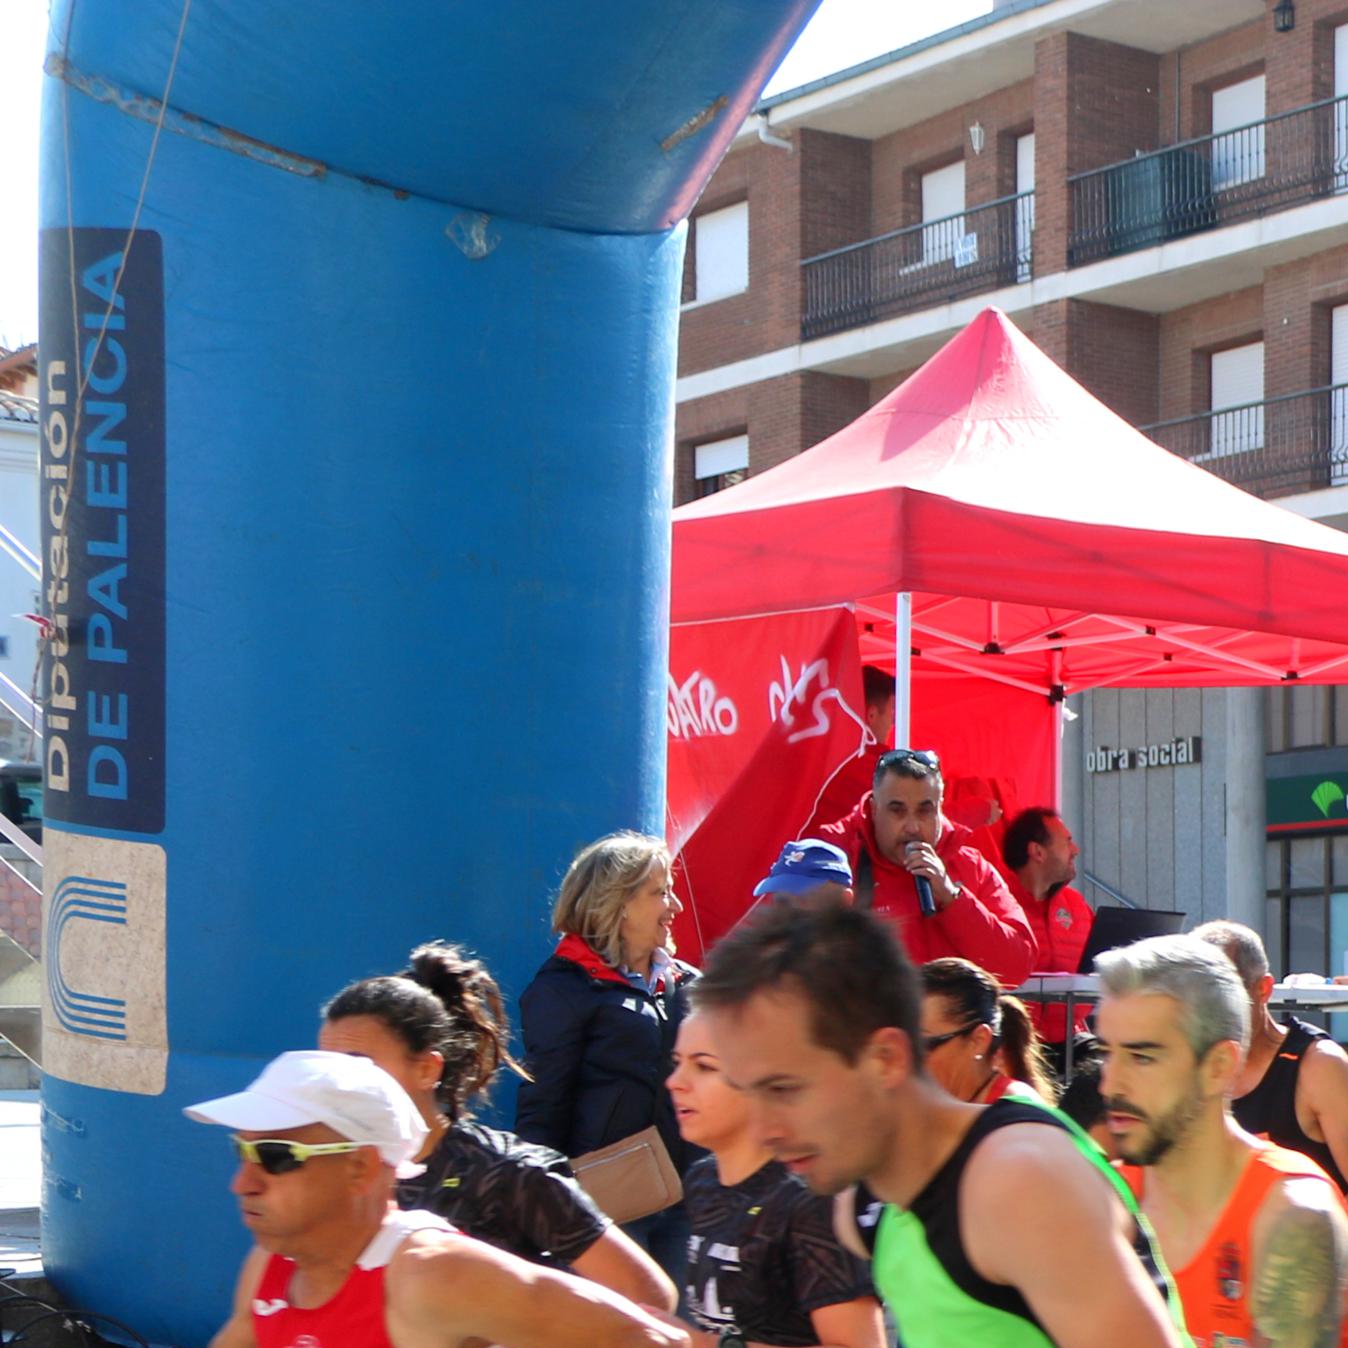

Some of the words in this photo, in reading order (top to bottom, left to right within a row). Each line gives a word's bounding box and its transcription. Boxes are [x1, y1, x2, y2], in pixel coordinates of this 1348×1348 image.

[44, 360, 70, 793] Diputación
[82, 250, 129, 664] PALENCIA
[87, 690, 128, 800] DE
[1086, 743, 1130, 773] obra
[1137, 737, 1195, 768] social
